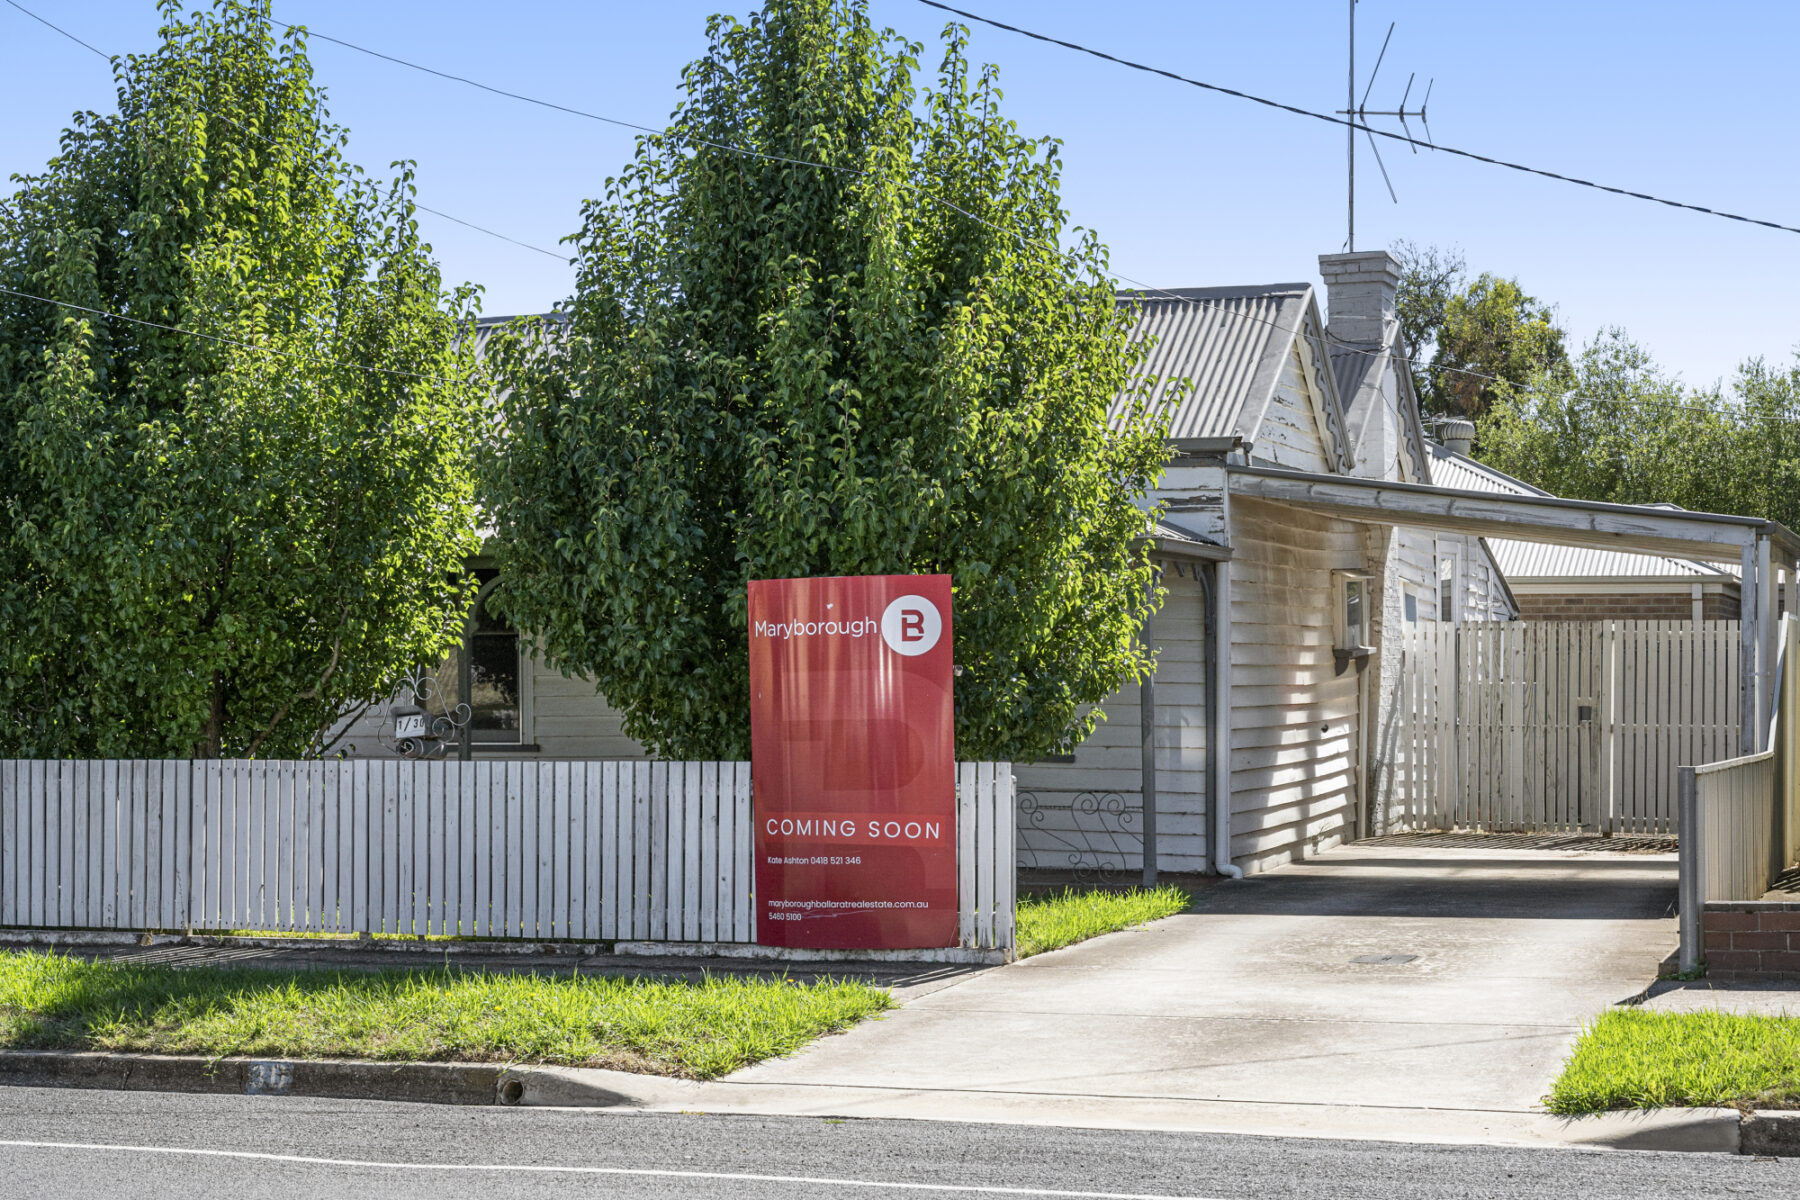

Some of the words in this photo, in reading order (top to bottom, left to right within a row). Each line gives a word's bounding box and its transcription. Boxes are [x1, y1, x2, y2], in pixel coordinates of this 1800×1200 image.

[755, 616, 878, 640] Maryborough
[901, 609, 925, 642] B
[766, 818, 856, 837] COMING
[868, 820, 940, 840] SOON
[767, 856, 783, 865] Kate
[784, 856, 809, 865] Ashton
[810, 856, 829, 865] 0418
[830, 856, 843, 865] 521
[845, 856, 862, 865] 346
[768, 899, 929, 911] maryboroughballaratrealestate.com.au
[768, 911, 785, 921] 5460
[785, 912, 802, 921] 5100
